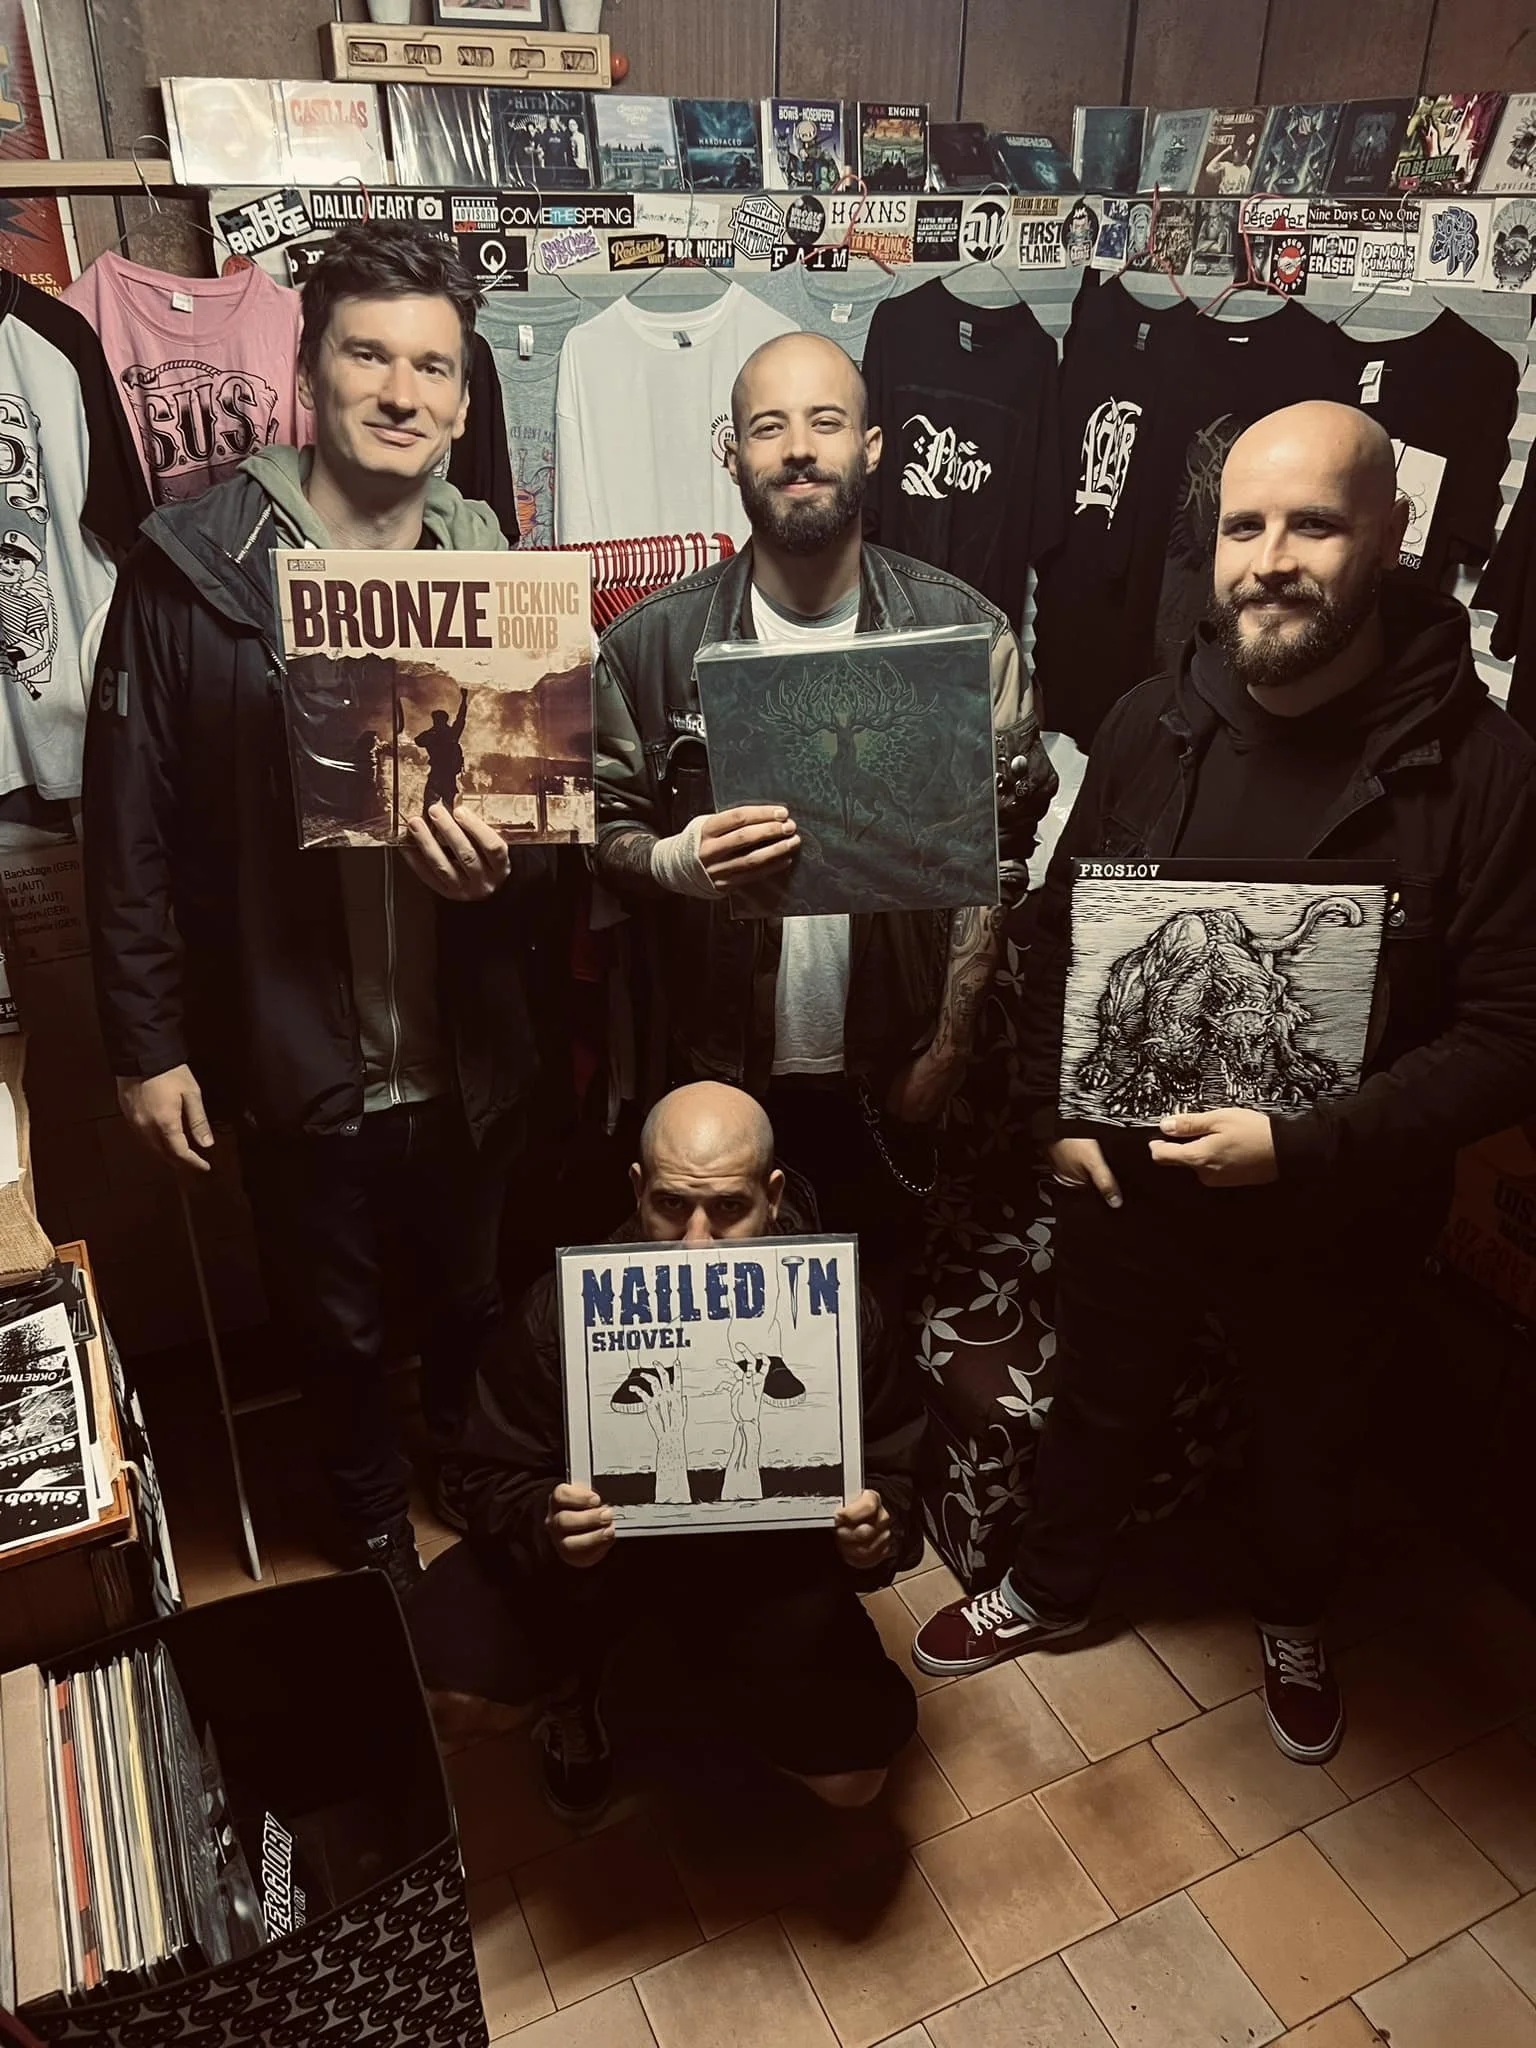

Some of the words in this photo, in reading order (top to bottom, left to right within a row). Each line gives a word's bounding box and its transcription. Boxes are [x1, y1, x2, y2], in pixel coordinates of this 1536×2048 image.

[290, 98, 369, 130] CASILLAS
[888, 106, 920, 118] ENGINE
[240, 193, 285, 226] THE
[312, 194, 414, 220] DALILOVEART
[455, 208, 497, 221] ADVISORY
[750, 201, 774, 220] SOFIA
[1308, 208, 1330, 221] Nine
[1333, 208, 1358, 225] Days
[1378, 208, 1393, 221] No
[1396, 208, 1420, 222] One
[227, 204, 312, 256] BRIDGE
[738, 211, 780, 236] HARDCORE
[1020, 221, 1064, 245] FIRST
[667, 239, 693, 259] FOR
[696, 239, 734, 258] NIGHT
[1019, 245, 1061, 264] FLAME
[1308, 255, 1355, 276] ERASER
[289, 578, 493, 649] BRONZE
[495, 581, 580, 616] TICKING
[497, 616, 559, 649] BOMB
[1079, 863, 1161, 878] PROSLOV
[581, 1260, 766, 1327] NAILED
[781, 1256, 841, 1331] IN
[591, 1327, 691, 1352] SHOVEL
[0, 1489, 81, 1506] Sukob
